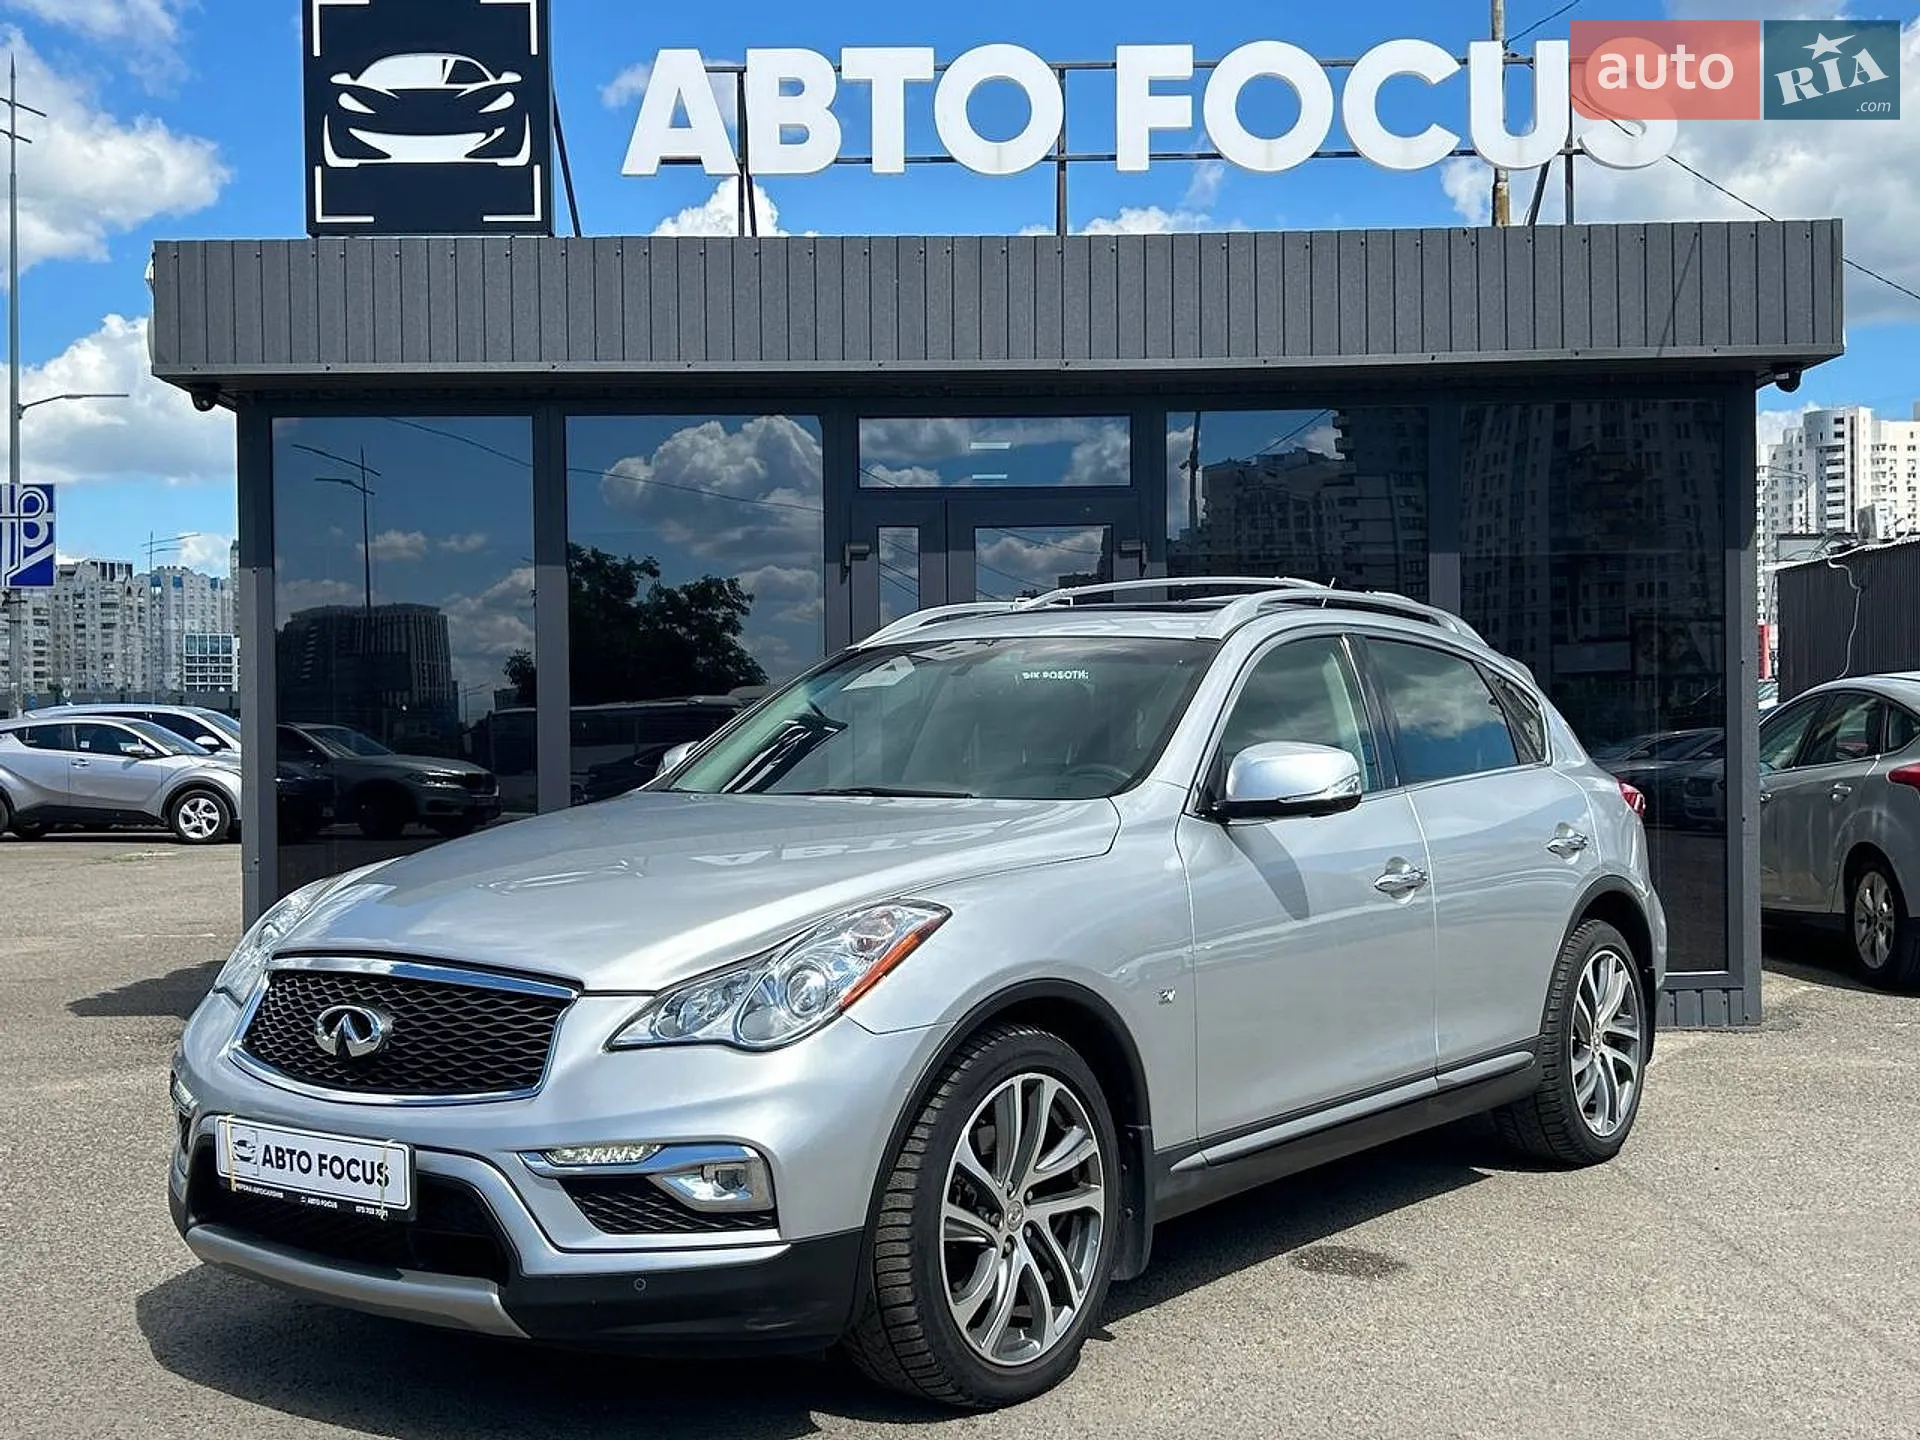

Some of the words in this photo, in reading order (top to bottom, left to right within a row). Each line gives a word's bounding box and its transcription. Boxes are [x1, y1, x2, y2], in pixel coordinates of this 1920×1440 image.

[621, 43, 1064, 175] АВТО
[1116, 38, 1677, 173] FOCUS
[262, 1144, 312, 1174] АВТО
[318, 1153, 389, 1187] FOCUS
